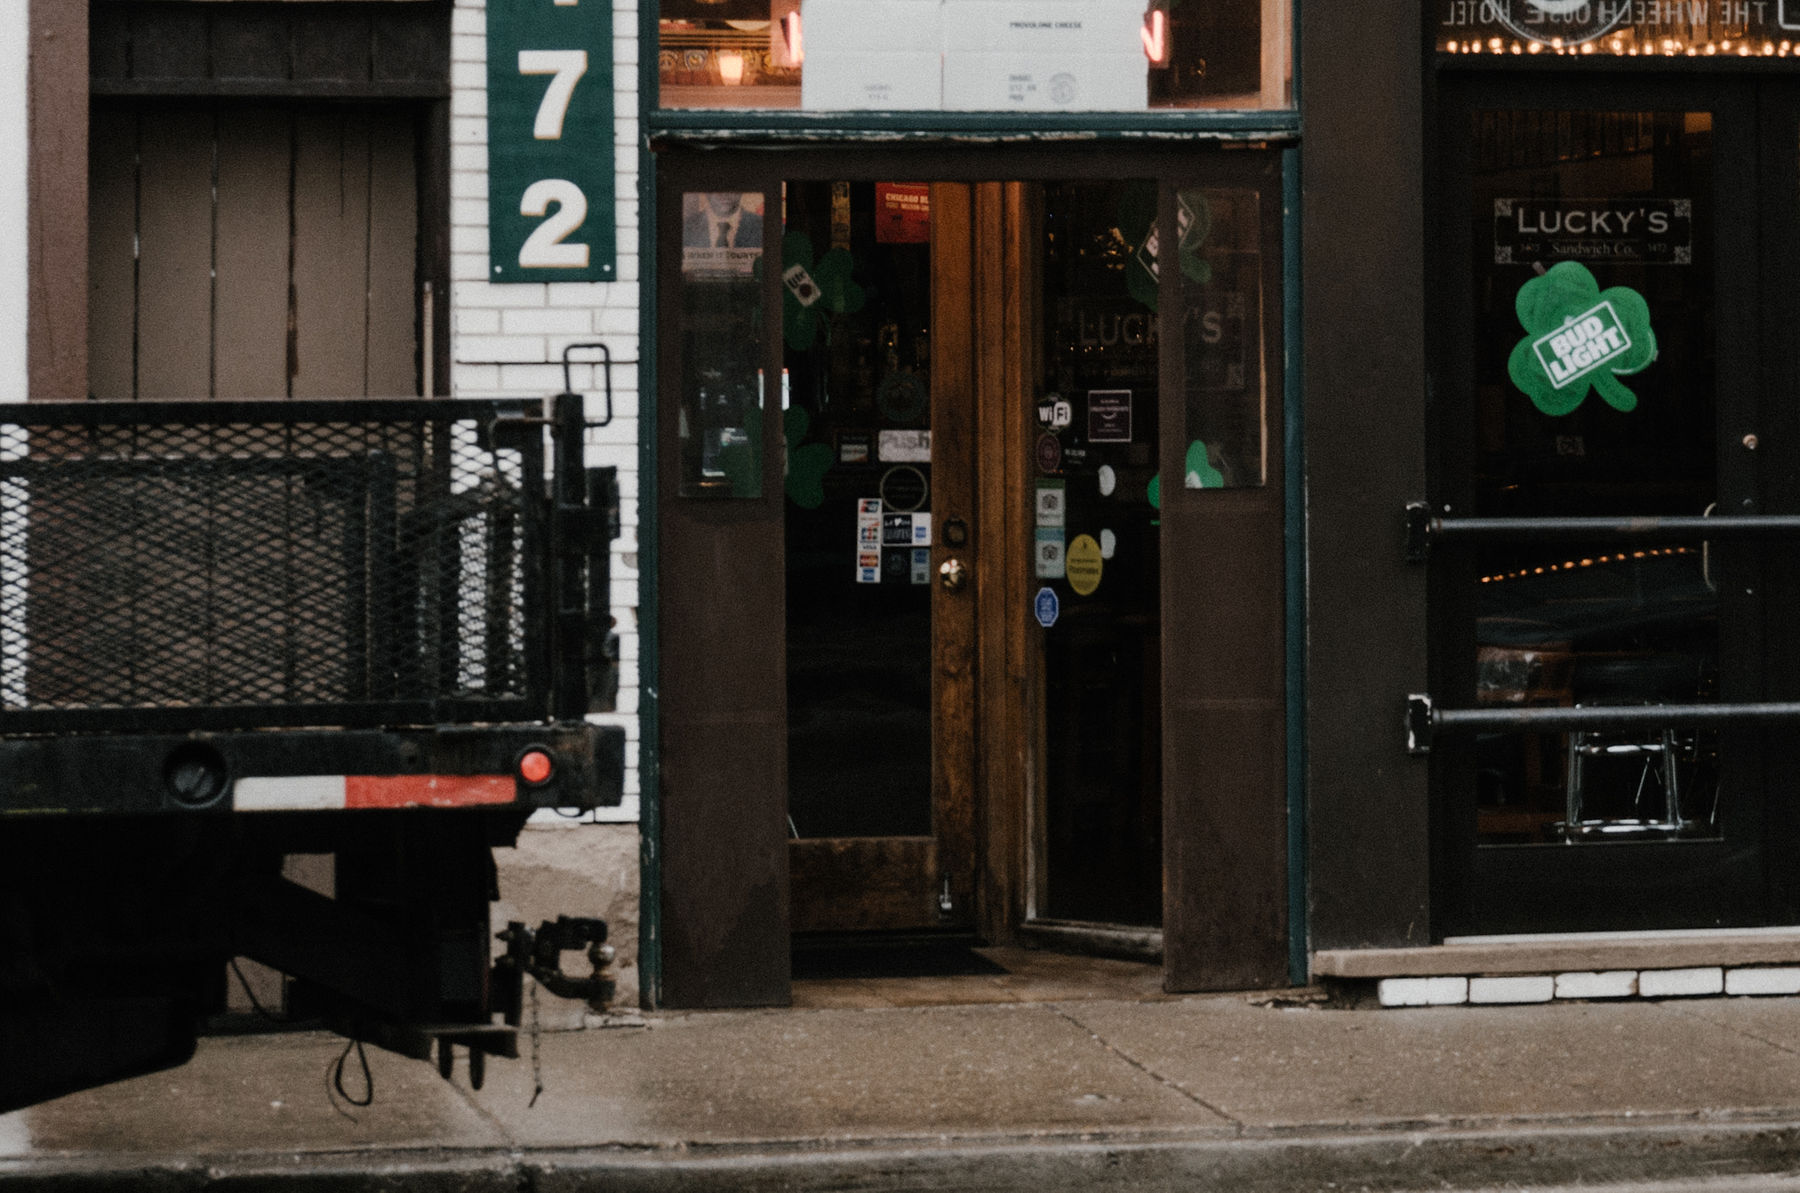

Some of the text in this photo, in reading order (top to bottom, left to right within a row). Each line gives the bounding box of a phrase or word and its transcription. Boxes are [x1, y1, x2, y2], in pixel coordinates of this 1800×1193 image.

[1517, 208, 1669, 233] LUCKY'S
[1551, 241, 1610, 254] Sandwich
[1550, 316, 1604, 358] BUD
[1550, 325, 1624, 382] LIGHT
